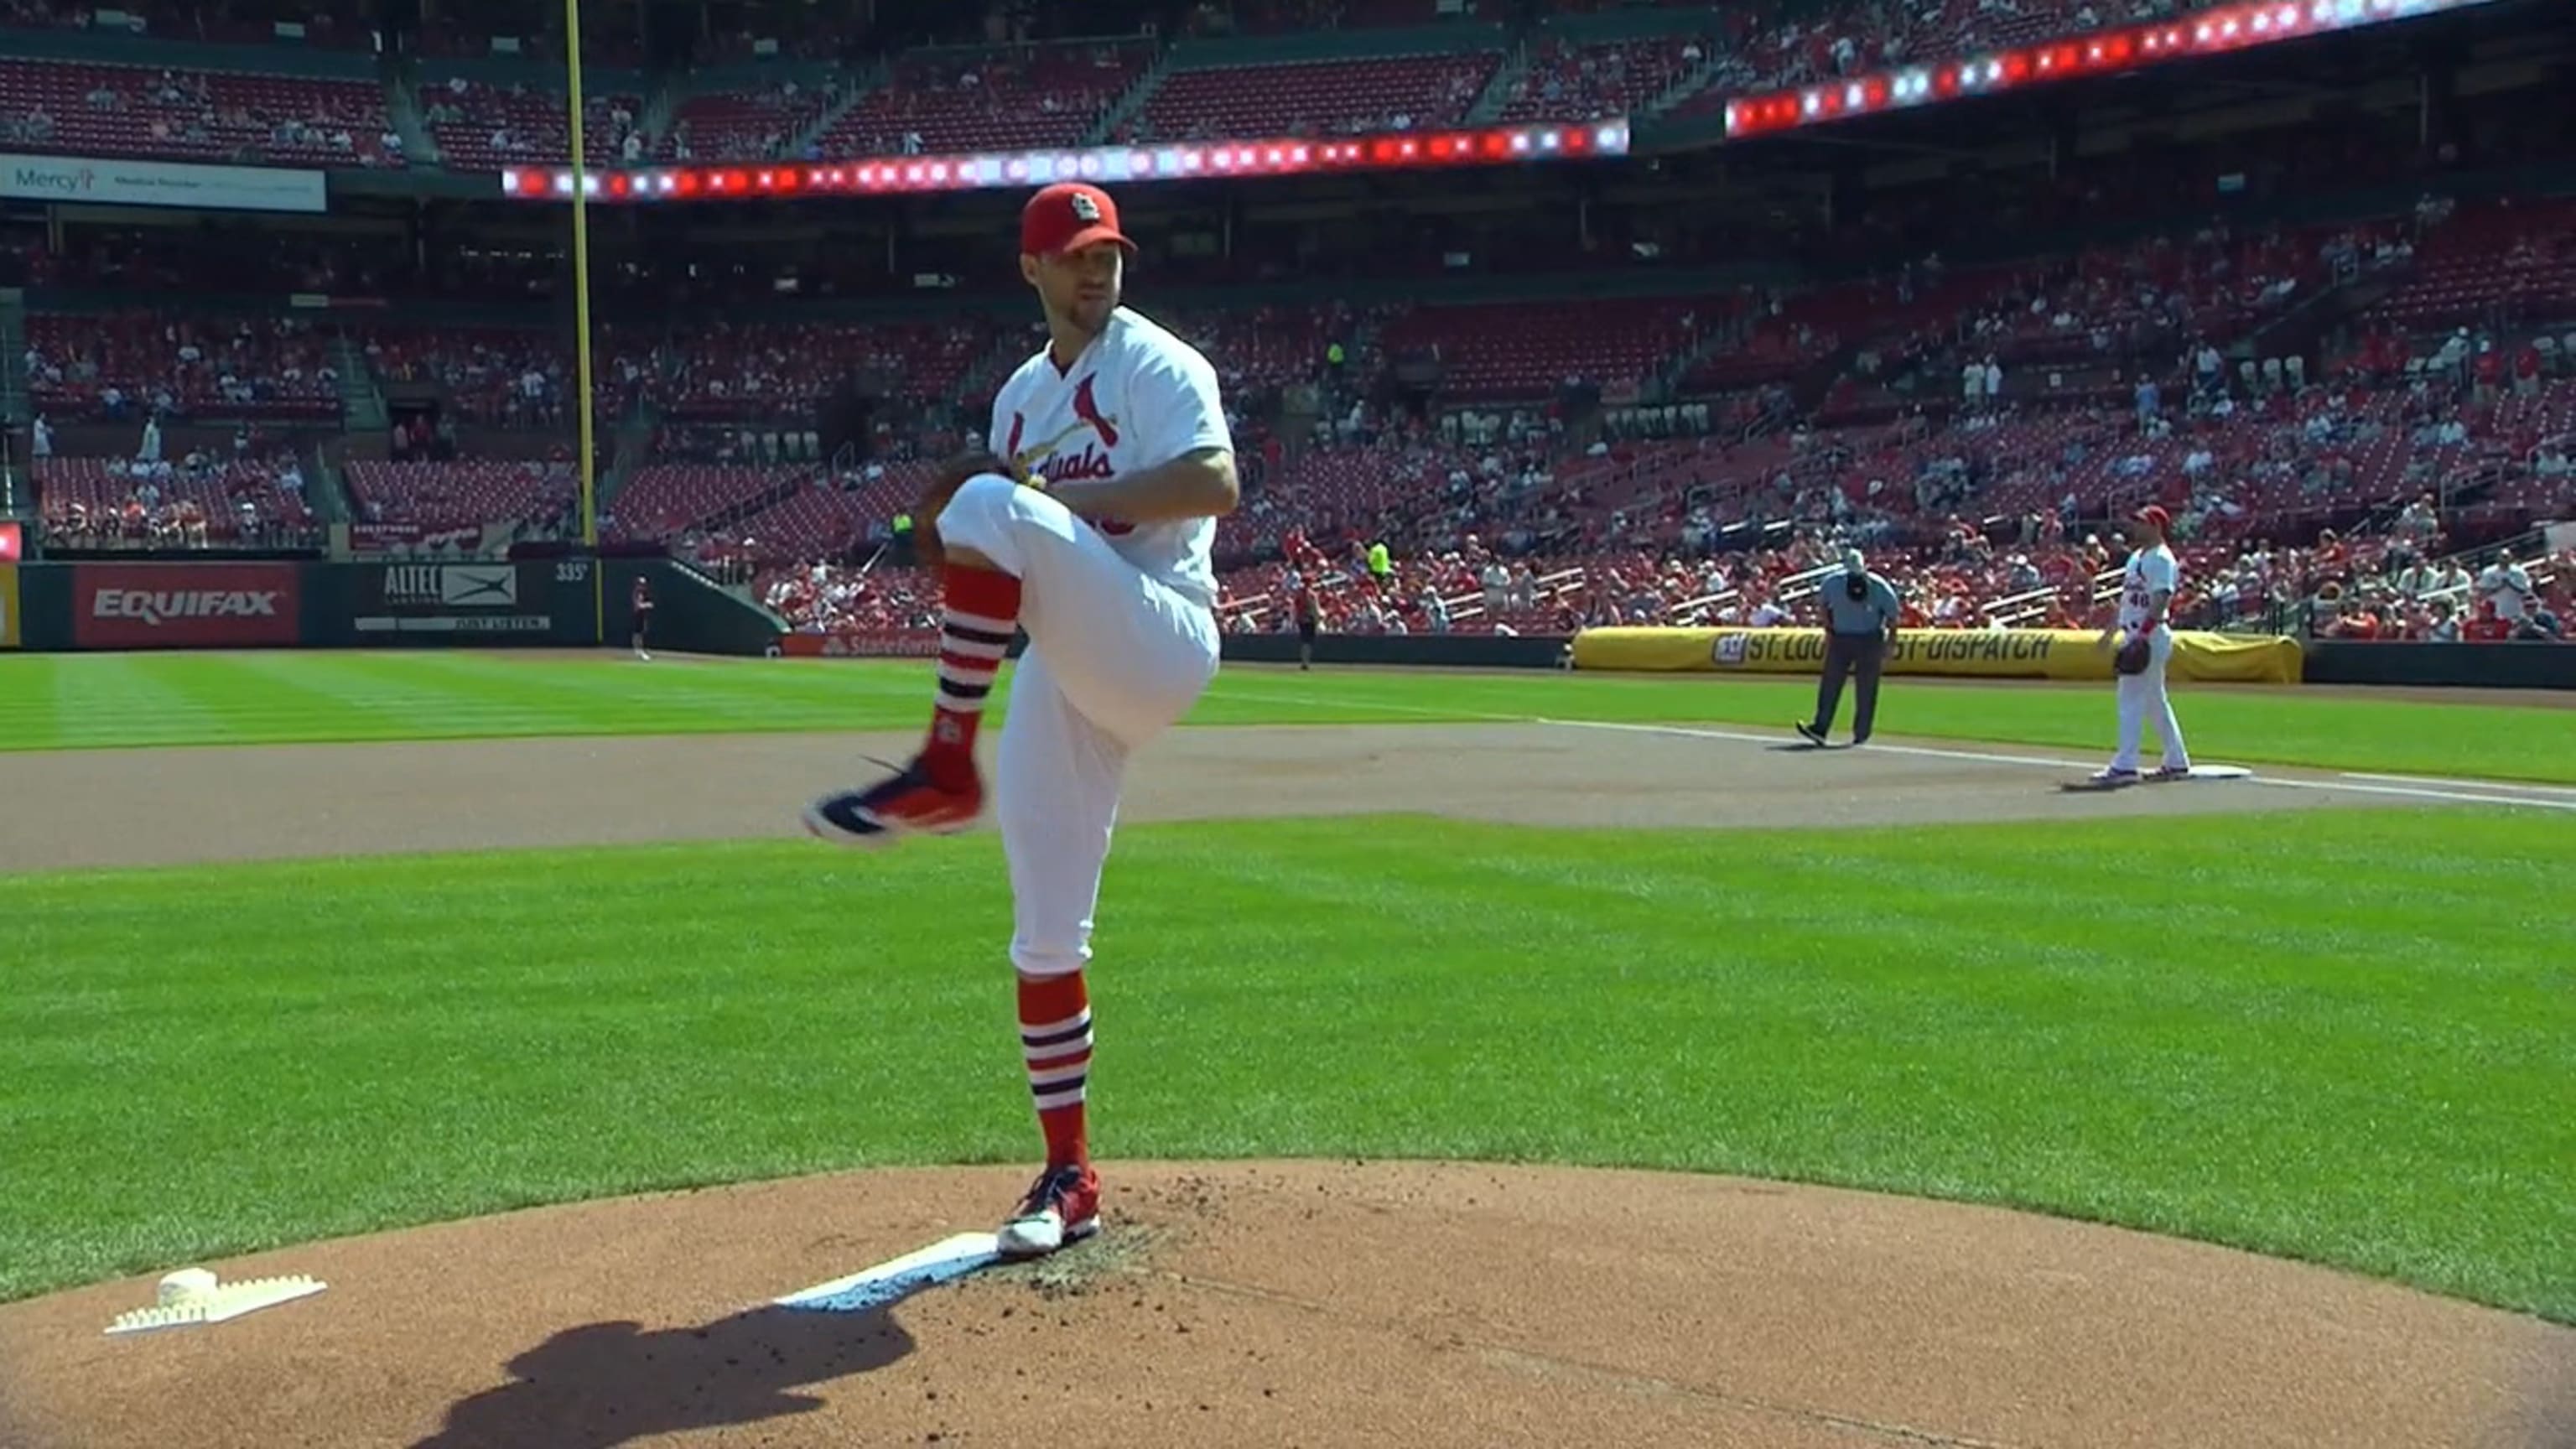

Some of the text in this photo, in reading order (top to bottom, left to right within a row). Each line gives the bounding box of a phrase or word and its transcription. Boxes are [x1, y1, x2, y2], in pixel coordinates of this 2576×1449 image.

[15, 169, 79, 193] Mercy
[384, 565, 441, 595] ALTEC
[93, 589, 277, 626] EQUIFAX
[1784, 634, 1827, 660] LOU
[1893, 633, 2054, 660] ST-DISPATCH
